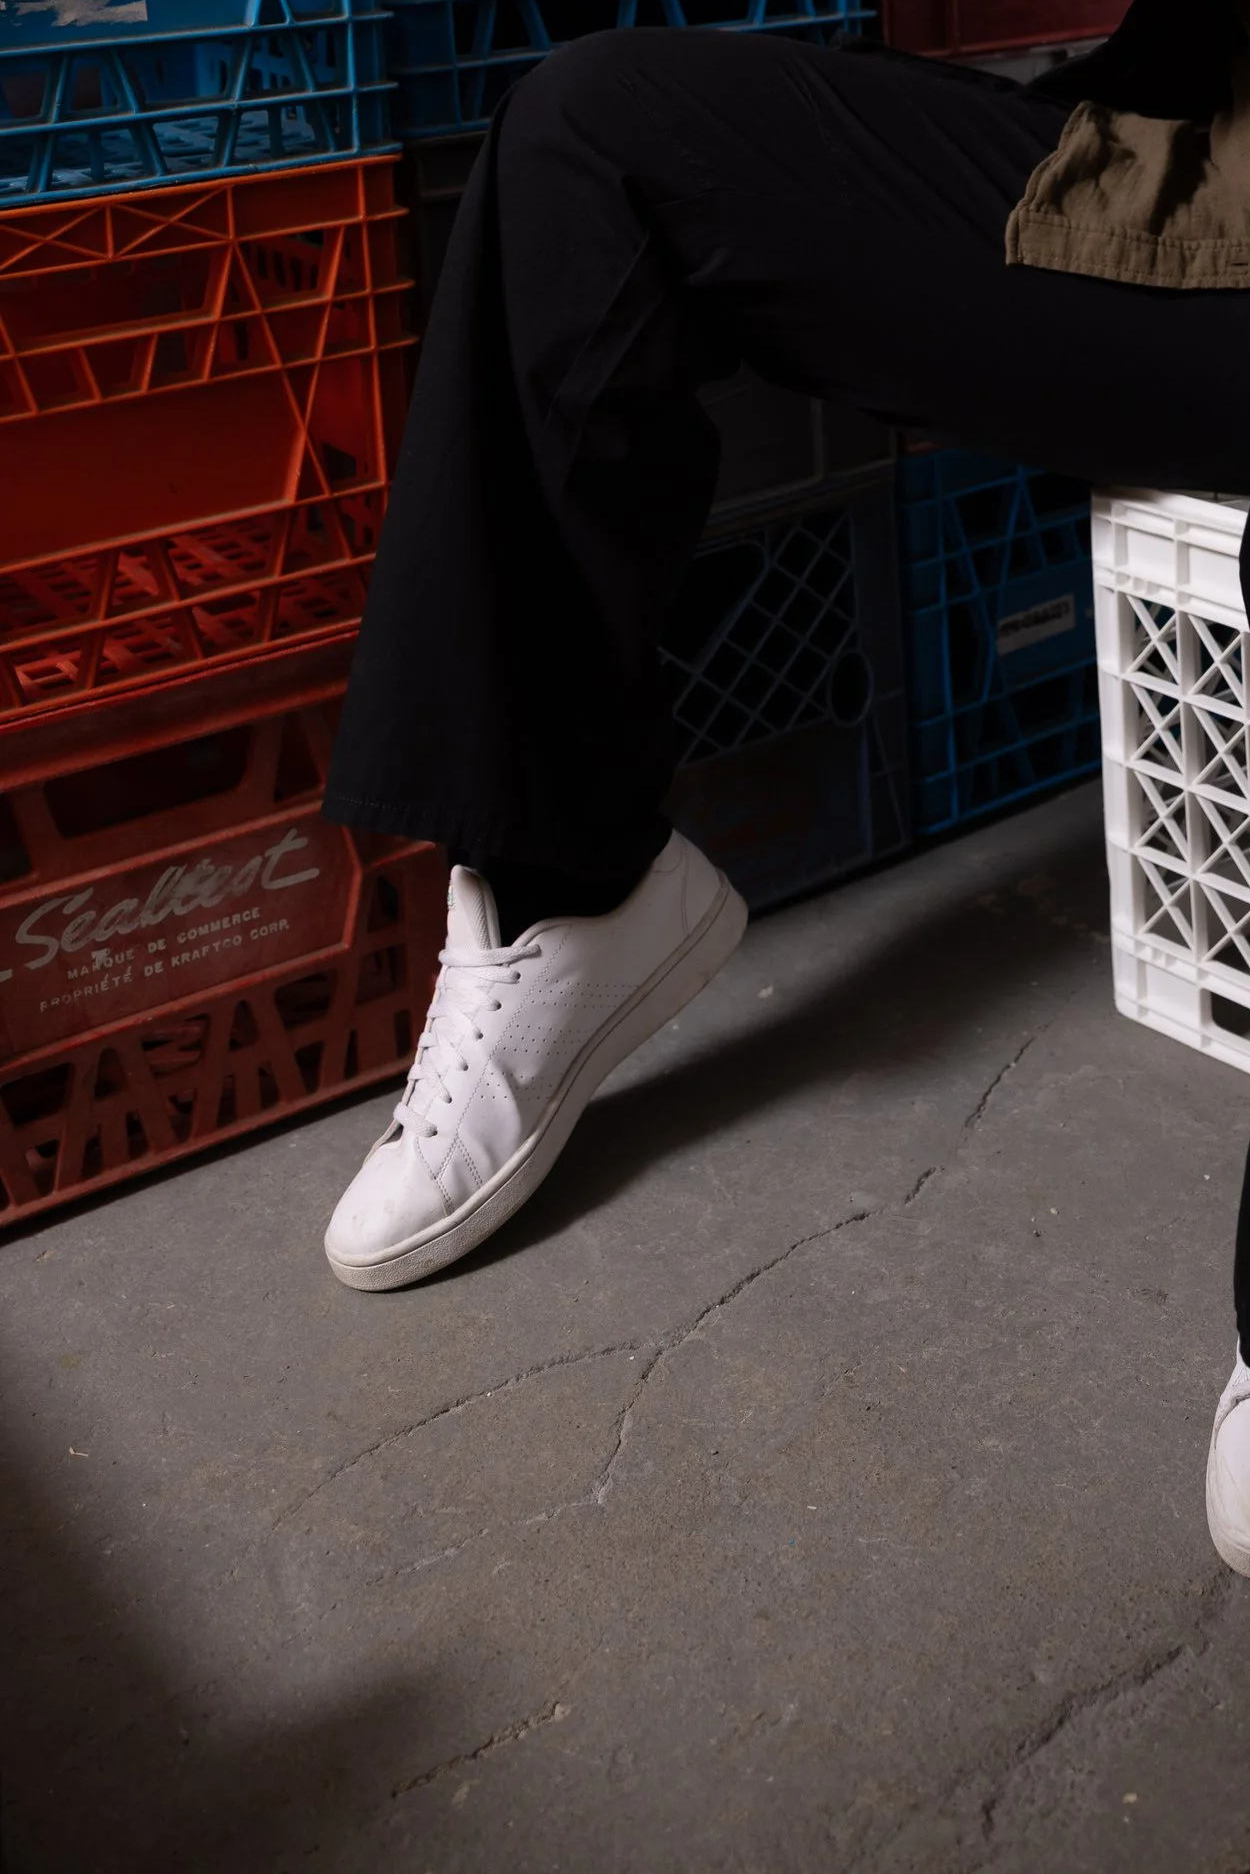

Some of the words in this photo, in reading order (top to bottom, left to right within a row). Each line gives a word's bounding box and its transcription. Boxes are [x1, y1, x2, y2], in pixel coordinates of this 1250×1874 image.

[0, 828, 321, 984] Sealtest
[67, 949, 136, 981] MARQUE
[147, 938, 168, 955] DE
[176, 907, 262, 945] COMMERCE
[39, 964, 134, 1014] PROPRIÉTÉ
[143, 960, 165, 979] DE
[171, 935, 244, 969] KRAFTCO
